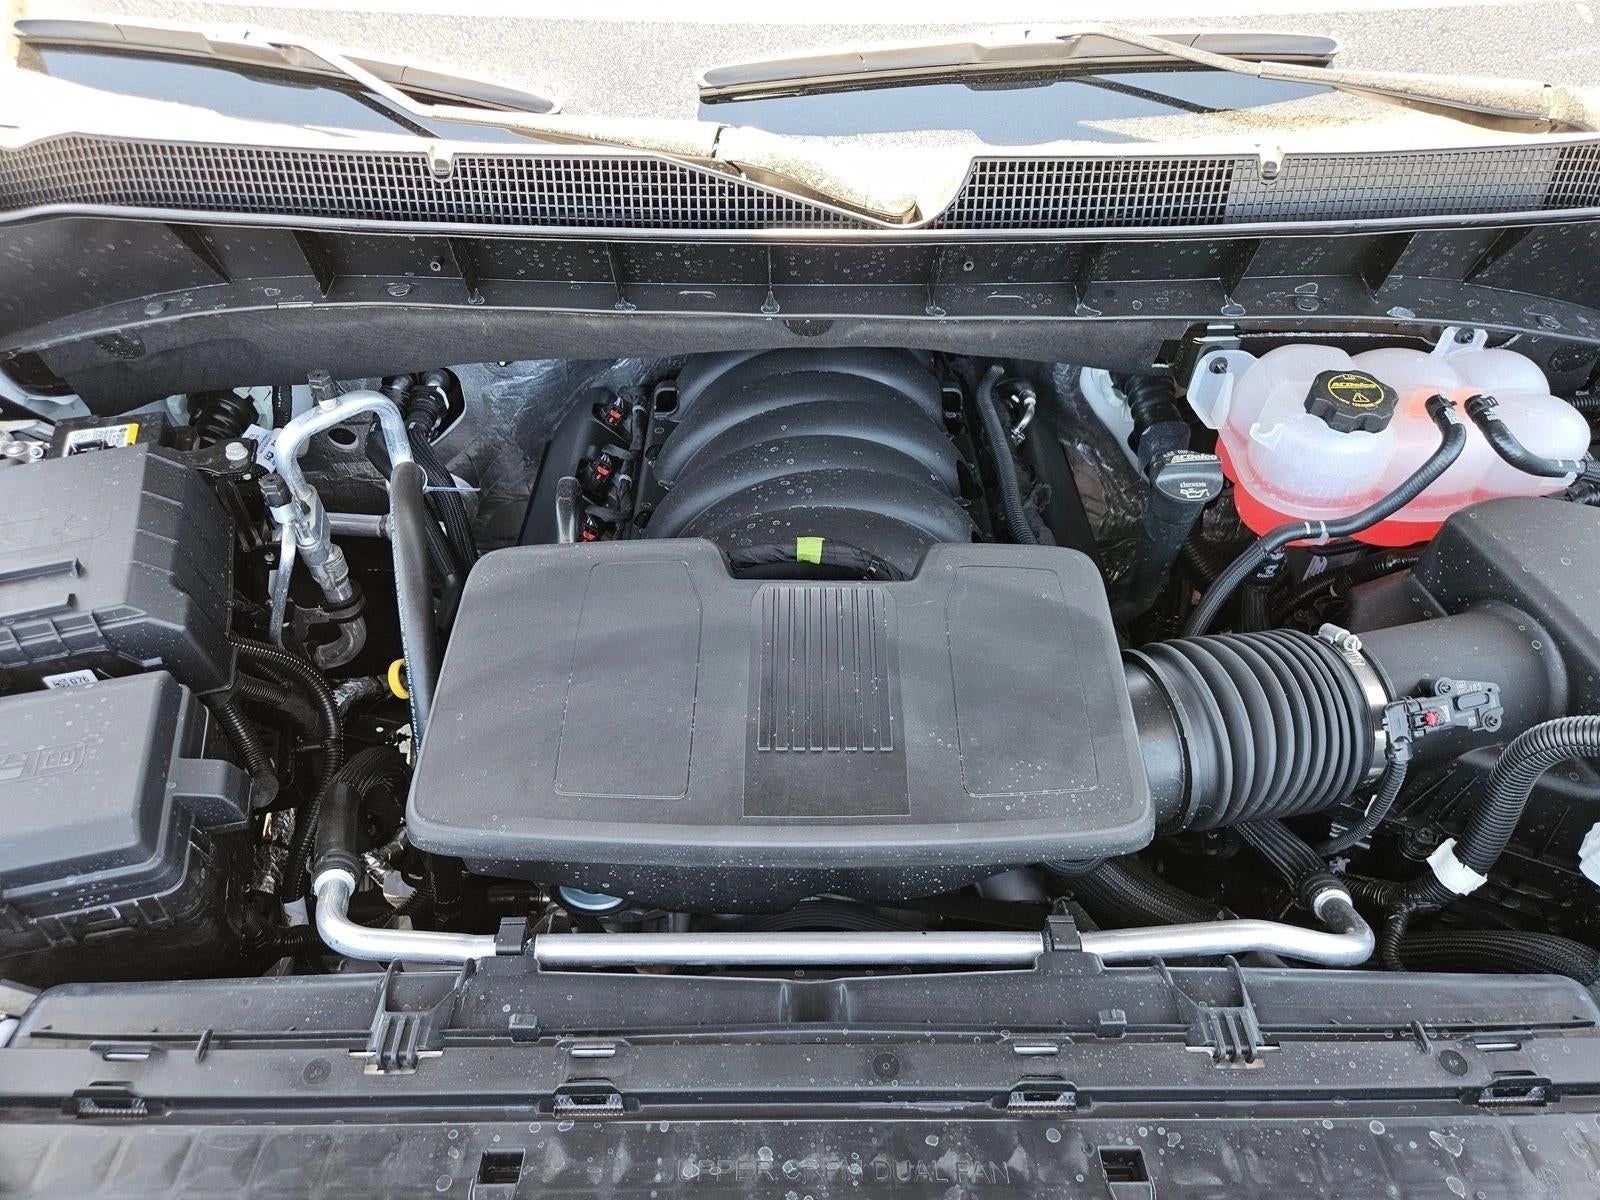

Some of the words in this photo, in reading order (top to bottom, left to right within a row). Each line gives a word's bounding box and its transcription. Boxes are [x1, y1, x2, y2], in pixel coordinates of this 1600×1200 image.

[678, 1159, 776, 1182] UPPER
[874, 1160, 949, 1183] DUAL
[956, 1160, 1010, 1184] FAN
